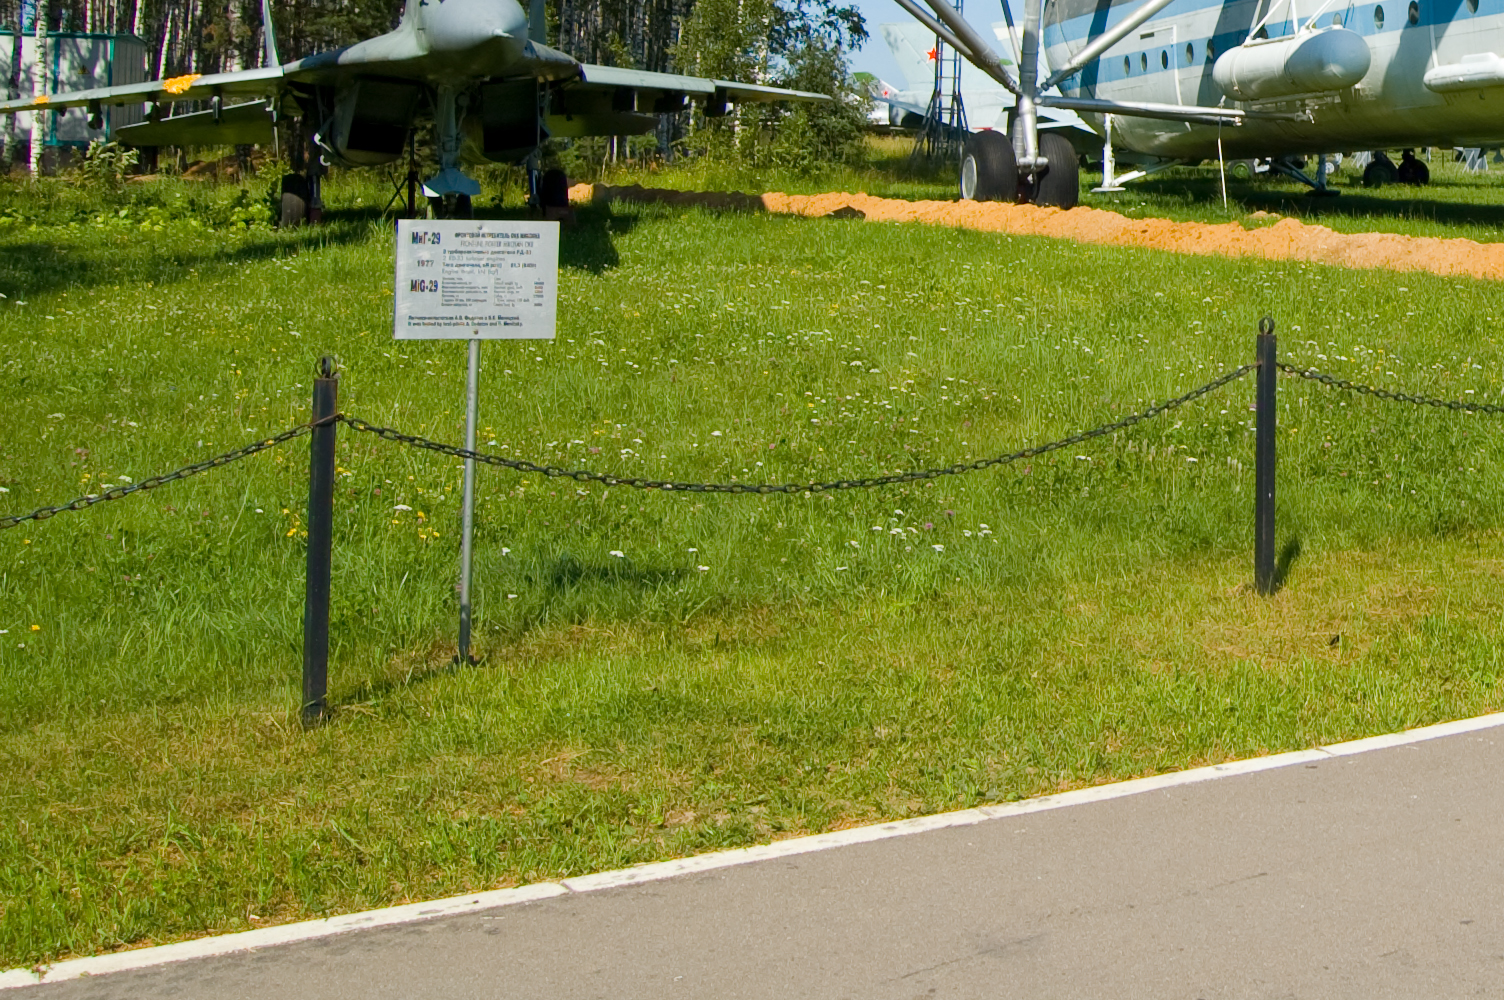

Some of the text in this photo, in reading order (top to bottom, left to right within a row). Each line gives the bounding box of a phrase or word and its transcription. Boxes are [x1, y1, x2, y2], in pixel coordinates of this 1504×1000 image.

[411, 231, 441, 245] МиГ-29
[417, 259, 435, 267] 1977
[410, 278, 439, 293] MiG-29
